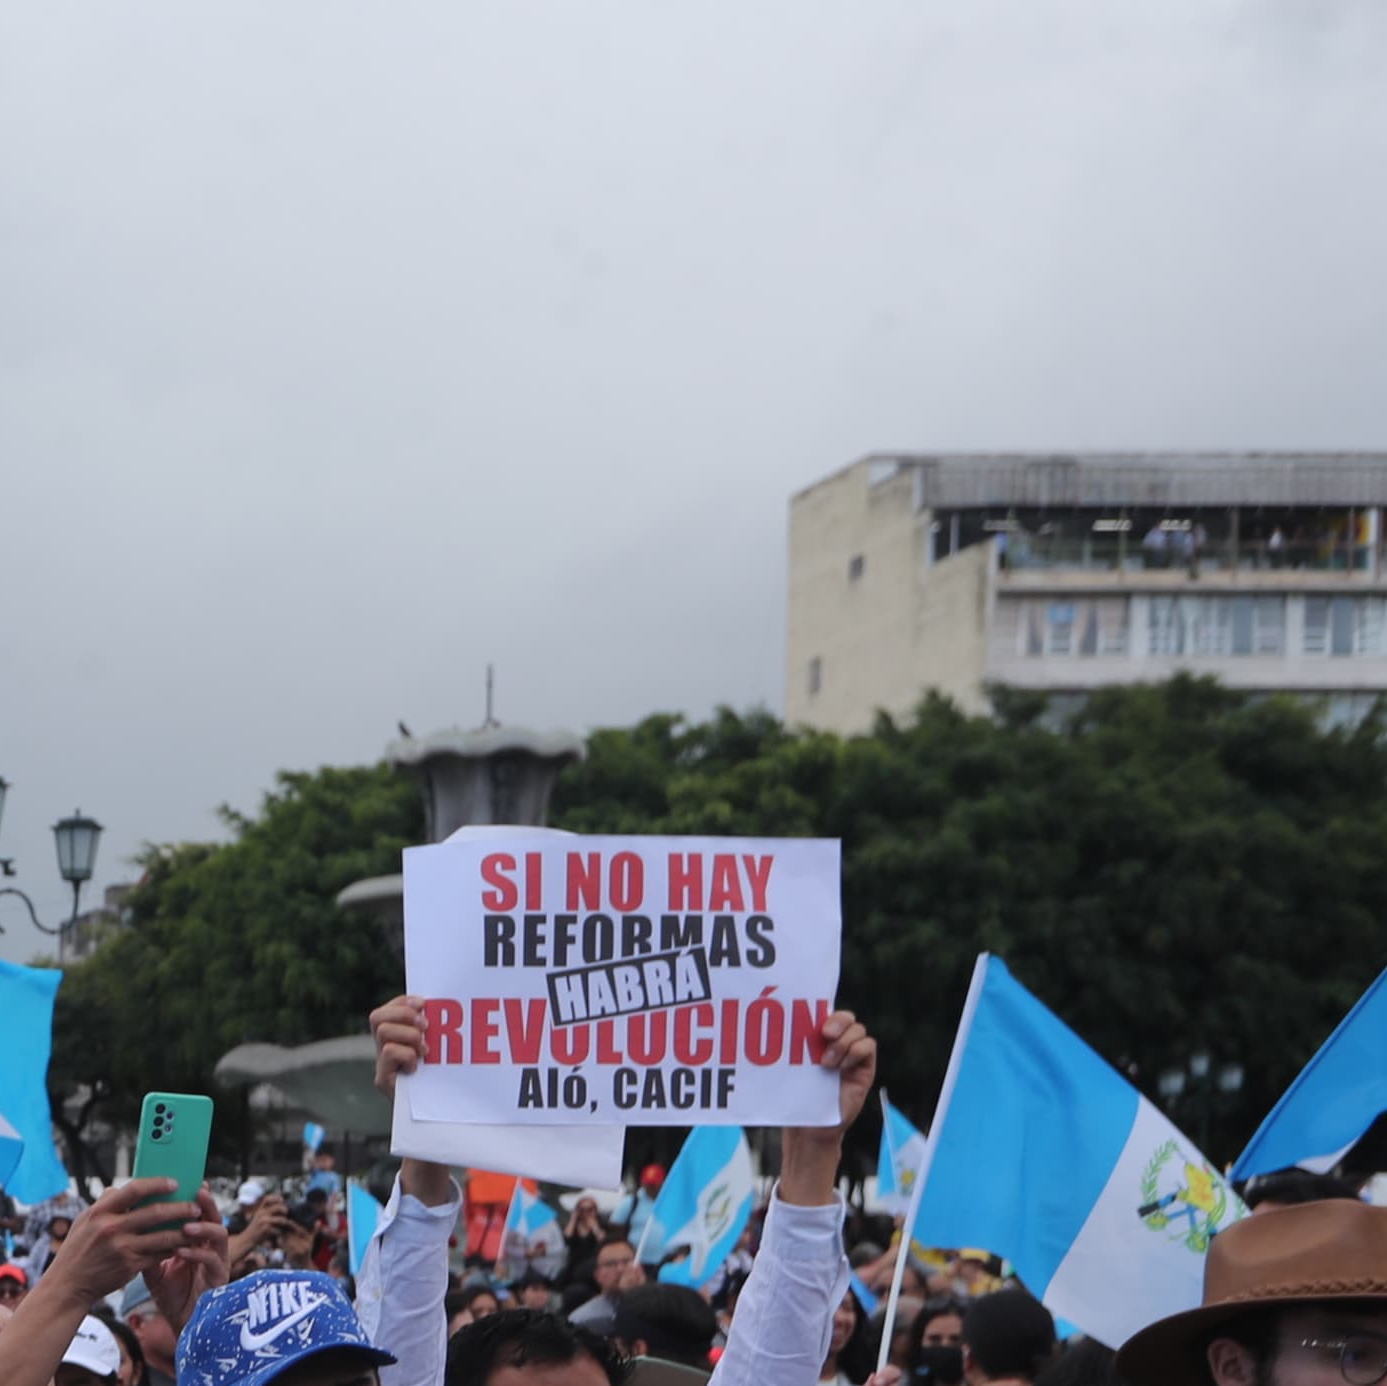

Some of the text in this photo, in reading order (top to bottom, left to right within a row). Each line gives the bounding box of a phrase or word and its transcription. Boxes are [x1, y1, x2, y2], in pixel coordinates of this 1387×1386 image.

[480, 851, 774, 912] SI NO HAY
[484, 913, 776, 969] REFORMAS
[554, 947, 706, 1023] HABRÁ
[423, 985, 828, 1066] REVOLUCIÓN
[613, 1067, 736, 1110] CACIF
[247, 1281, 315, 1329] NIKE
